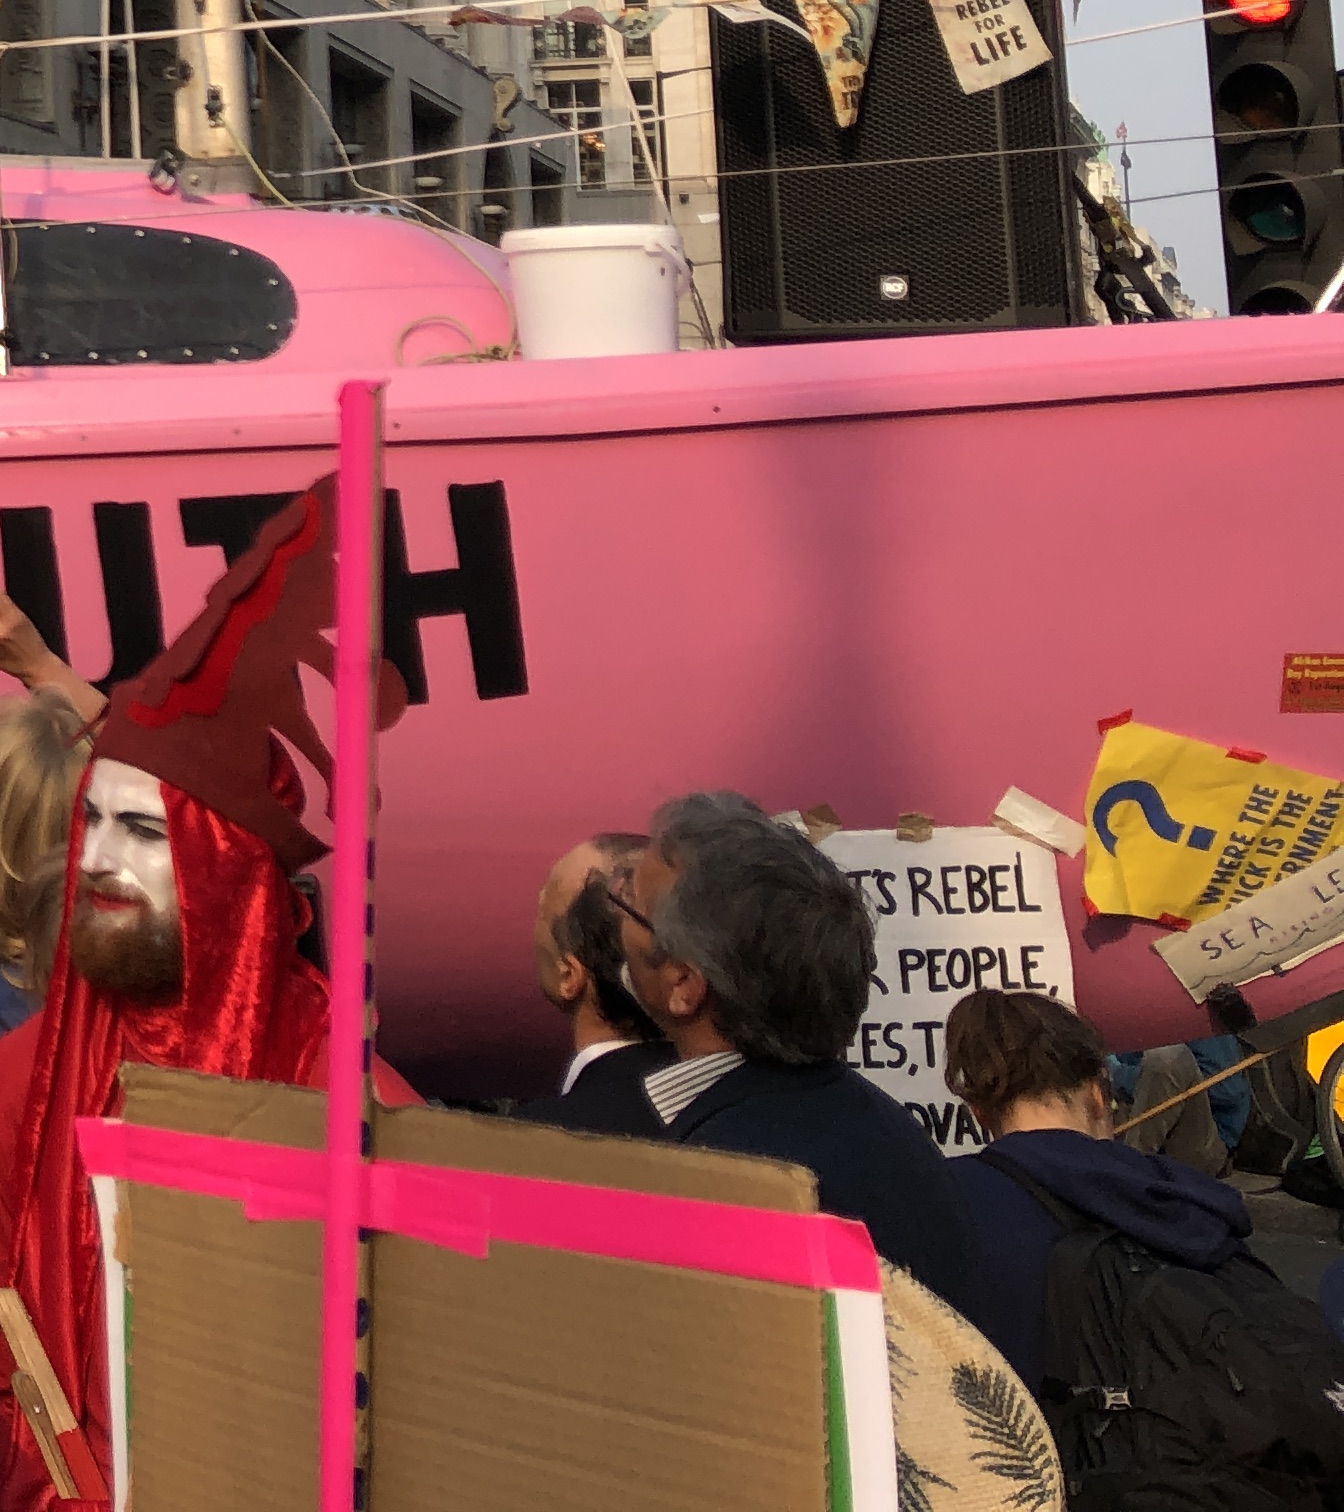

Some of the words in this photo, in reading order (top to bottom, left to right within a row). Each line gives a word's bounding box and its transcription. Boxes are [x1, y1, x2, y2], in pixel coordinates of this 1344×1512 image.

[970, 25, 1027, 66] LIFE
[974, 14, 1005, 33] FOR
[1197, 830, 1256, 906] WHERE
[1239, 783, 1279, 825] THE
[1225, 861, 1271, 910] UCK
[1256, 836, 1285, 857] IS
[1272, 789, 1313, 828] THE
[1274, 787, 1344, 882] RNMENT
[907, 851, 1042, 917] REBEL
[1200, 915, 1274, 960] SEA
[898, 944, 1059, 997] PEOPLE,
